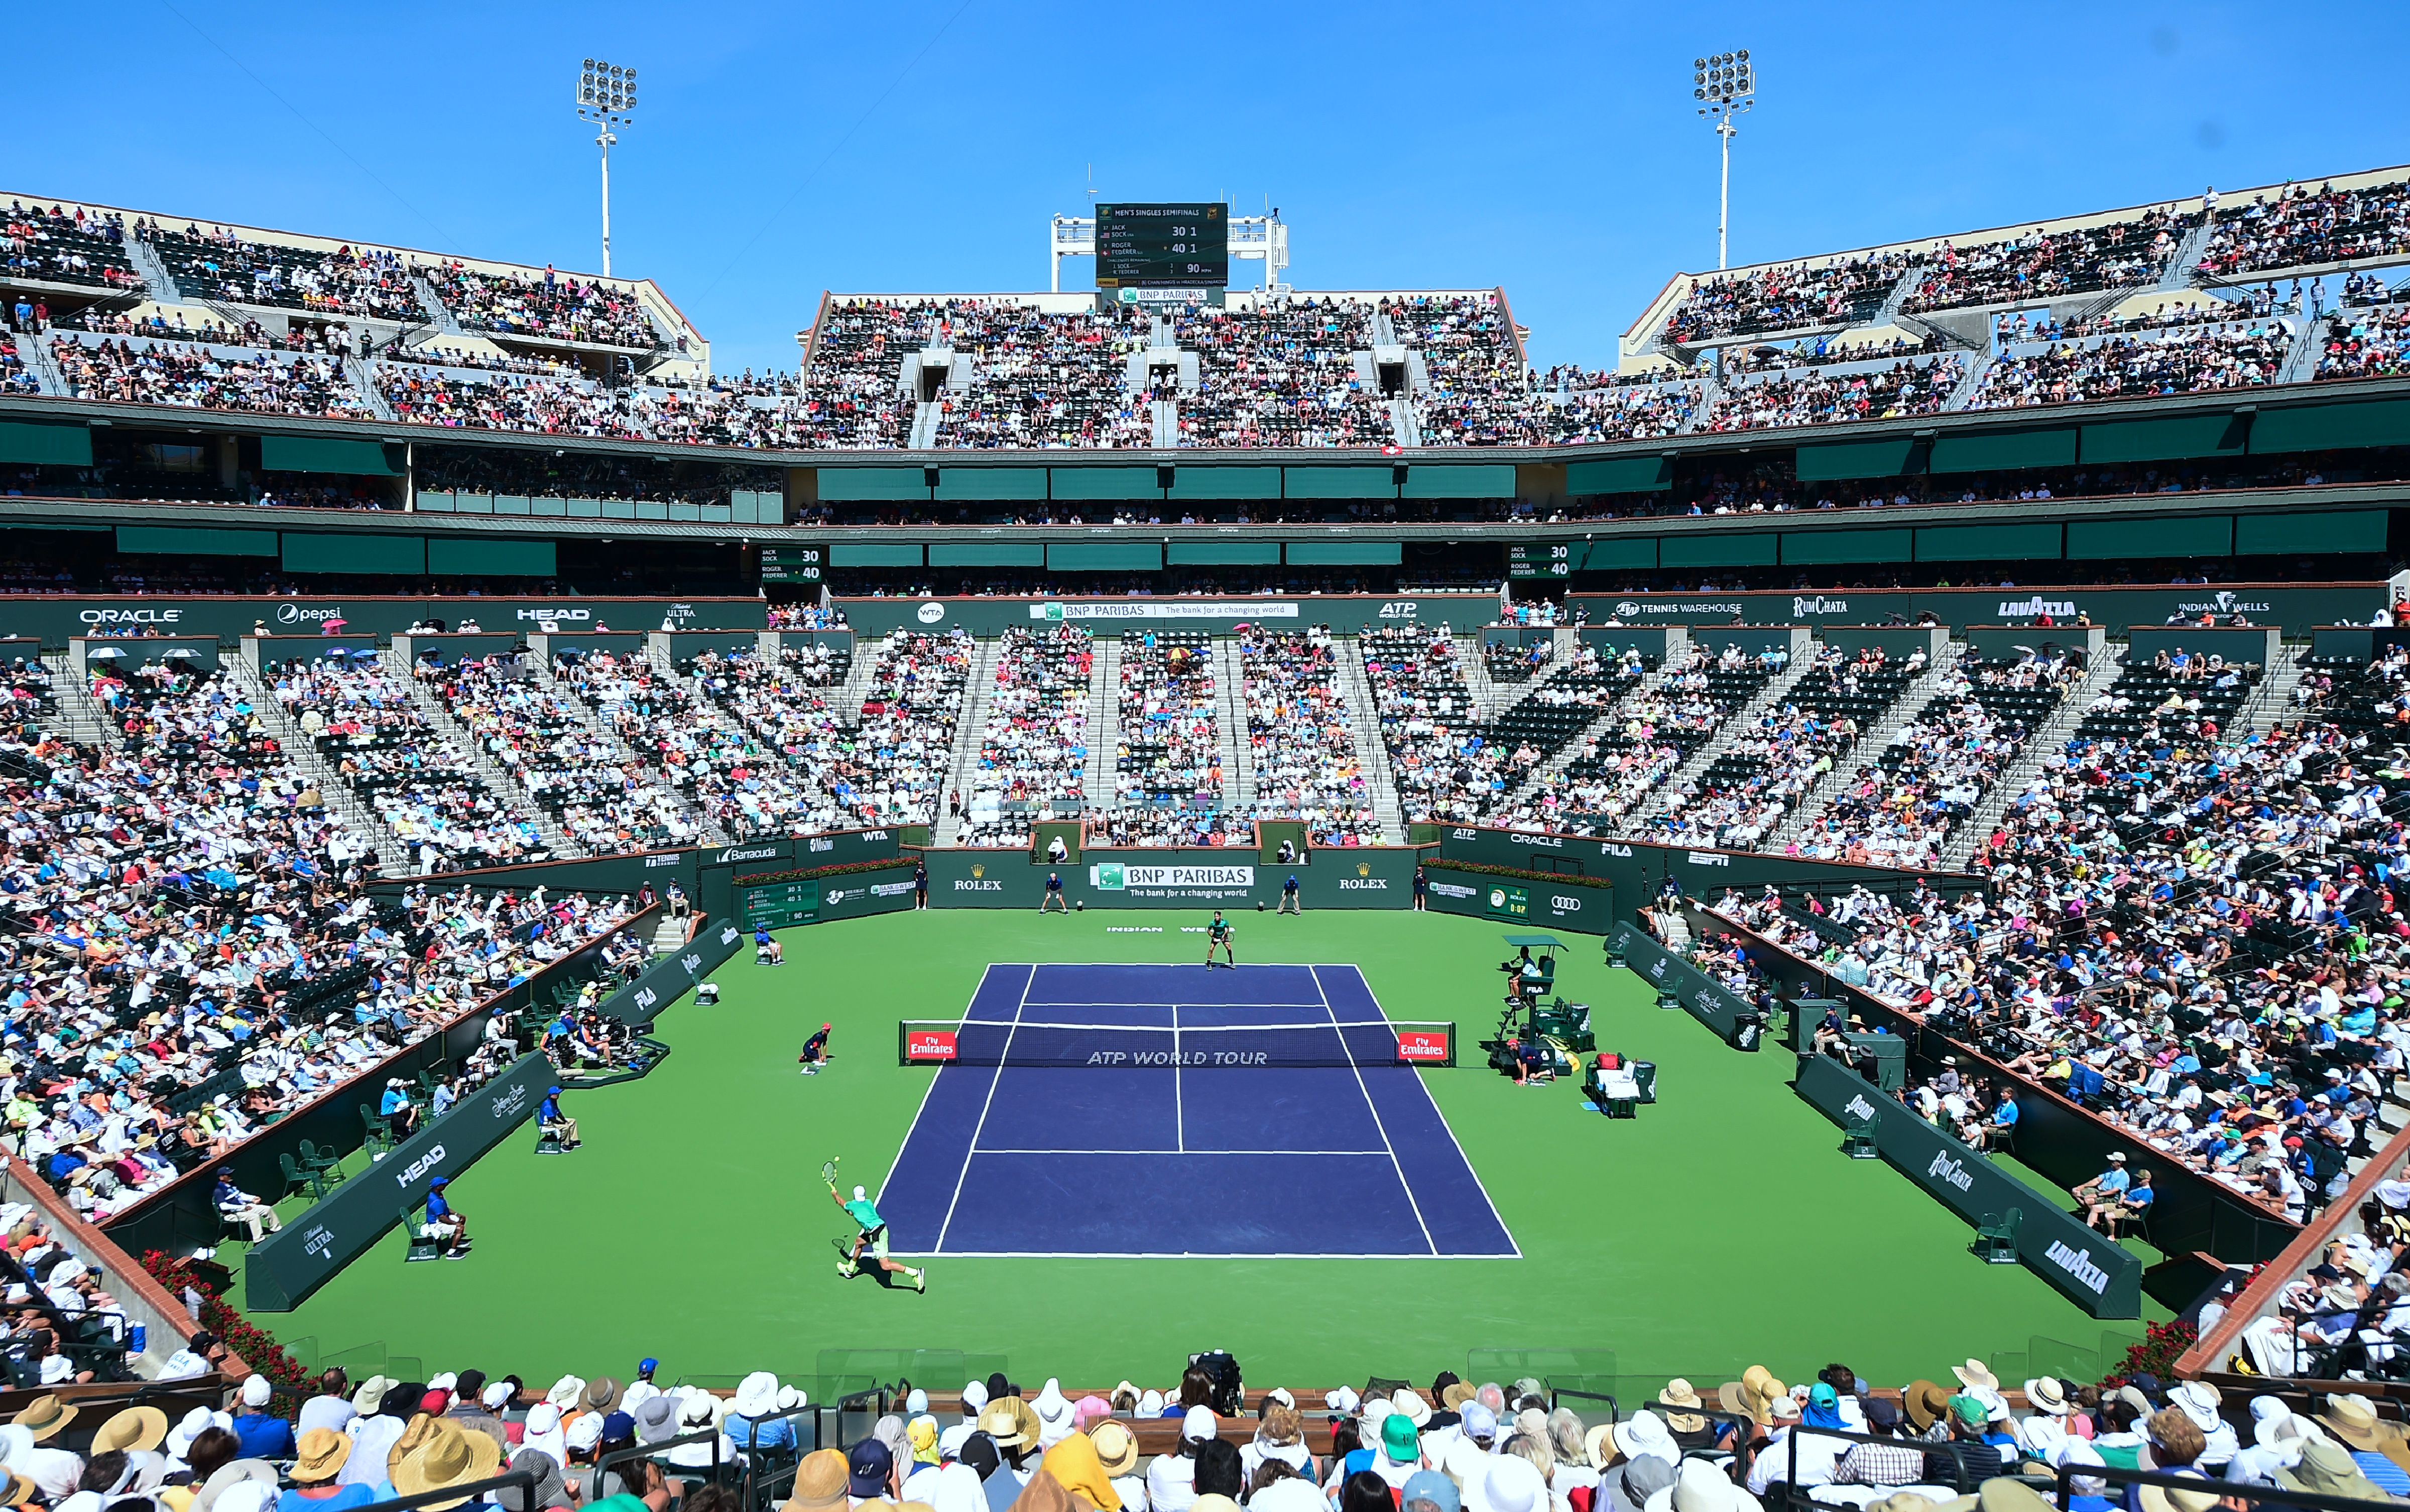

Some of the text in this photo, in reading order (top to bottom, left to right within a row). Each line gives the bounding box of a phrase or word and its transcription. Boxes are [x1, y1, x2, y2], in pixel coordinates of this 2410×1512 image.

[1172, 226, 1197, 236] 30 1
[1172, 243, 1197, 253] 40 1
[1187, 264, 1199, 273] 90
[1140, 291, 1159, 299] BNP
[802, 550, 819, 562] 30
[1551, 546, 1567, 558] 30
[802, 567, 819, 578] 40
[1551, 563, 1569, 575] 40
[1066, 605, 1145, 616] BNP PARIBAS
[1165, 605, 1179, 614] The
[1182, 605, 1200, 614] bank
[1203, 606, 1216, 616] for
[1224, 605, 1259, 616] changing
[1262, 605, 1284, 614] world
[1379, 602, 1417, 613] ATP
[1641, 602, 1742, 613] TENNIS WAREHOUSE
[1998, 596, 2076, 616] LAVAZZA
[2179, 603, 2269, 611] INDIAN WELLS
[80, 609, 180, 622] ORACLE
[300, 606, 342, 621] pepsi
[517, 609, 589, 620] HEAD
[863, 831, 888, 842] WTA
[1453, 828, 1476, 837] ATP
[1510, 833, 1562, 847] ORACLE
[732, 847, 776, 861] Barracuda
[1601, 843, 1632, 857] FILA
[657, 854, 680, 862] TENNIS
[1688, 851, 1729, 866] ESPN
[1130, 868, 1247, 883] BNP PARIBAS
[899, 881, 915, 889] WEST
[954, 880, 1002, 891] ROLEX
[1339, 879, 1387, 889] ROLEX
[1130, 889, 1143, 897] The
[1146, 889, 1165, 897] bank
[1166, 889, 1178, 899] for
[1187, 889, 1223, 899] changing
[1224, 889, 1247, 897] world
[1510, 904, 1526, 914] 0:07
[633, 986, 657, 1012] FILA
[925, 1036, 938, 1046] Fly
[1415, 1037, 1429, 1047] Fly
[910, 1042, 953, 1055] Emirates
[1400, 1043, 1444, 1056] Emirates
[1087, 1052, 1267, 1065] ATP WORLD TOUR
[396, 1144, 446, 1188] HEAD
[305, 1230, 335, 1255] ULTRA
[2044, 1239, 2110, 1295] LAVAZZA
